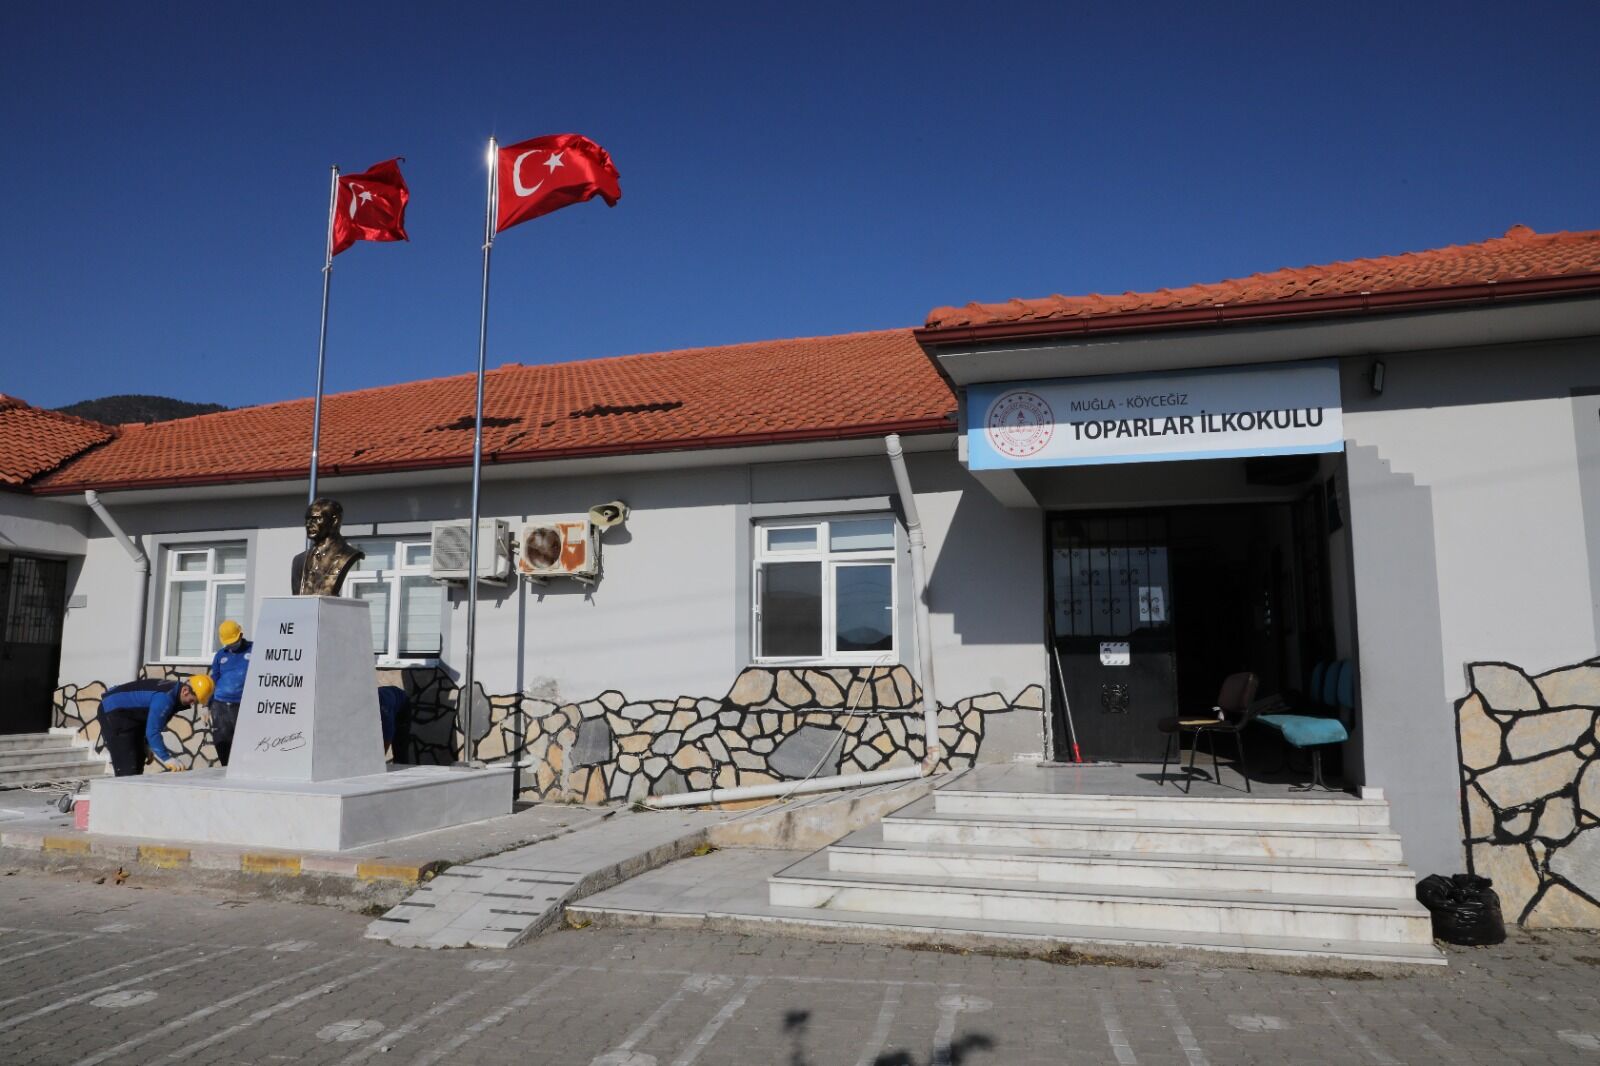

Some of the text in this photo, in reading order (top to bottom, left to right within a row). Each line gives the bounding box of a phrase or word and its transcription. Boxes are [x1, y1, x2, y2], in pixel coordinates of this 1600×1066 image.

[1070, 398, 1116, 412] MUĞLA
[1126, 393, 1188, 408] KÖYCEĞİZ
[1070, 415, 1195, 441] TOPARLAR
[1200, 406, 1323, 433] İLKOKULU
[279, 622, 295, 635] NE
[265, 648, 302, 661] MUTLU
[258, 673, 304, 688] TÜRKÜM
[257, 699, 297, 715] DİYENE
